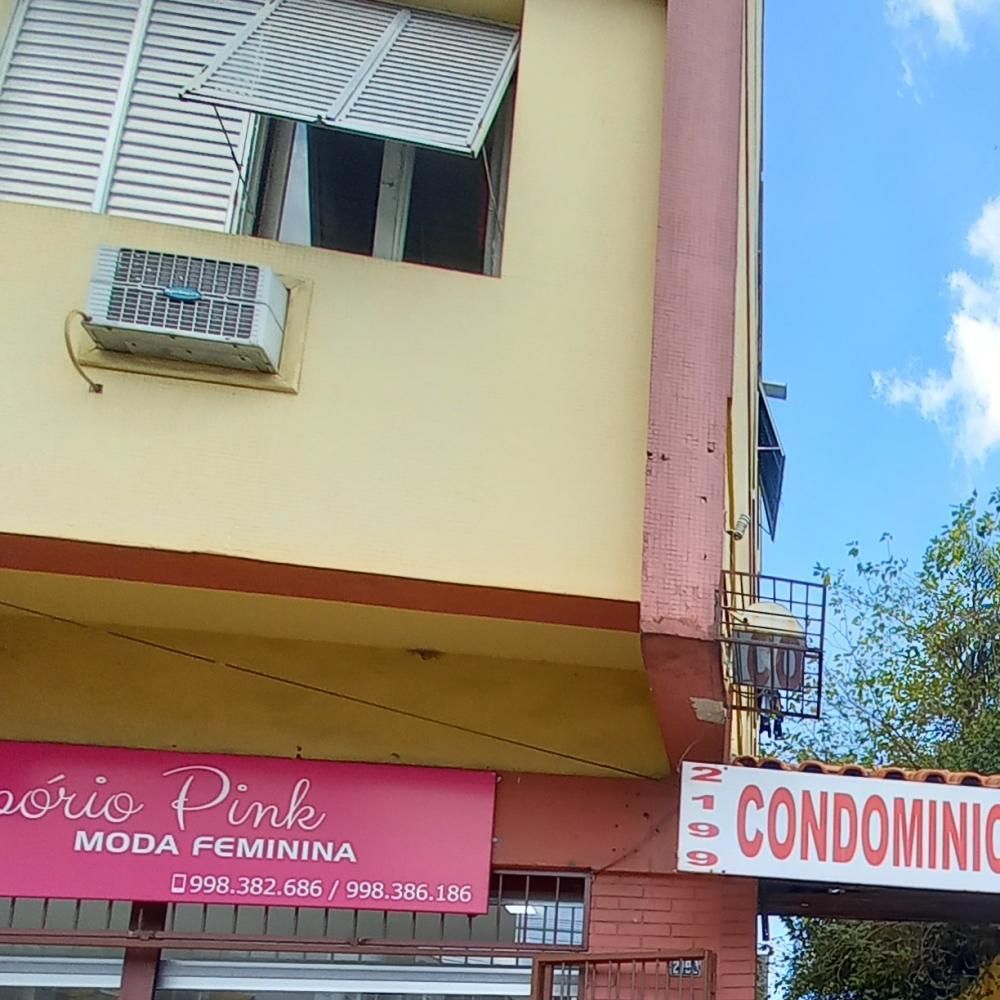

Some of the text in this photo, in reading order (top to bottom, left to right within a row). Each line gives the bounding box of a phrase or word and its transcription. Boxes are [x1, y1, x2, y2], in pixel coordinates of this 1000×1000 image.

[163, 765, 327, 831] Pink
[686, 766, 723, 867] 2199
[74, 830, 358, 863] MODA FEMININA
[189, 875, 323, 898] 998.382.686
[345, 880, 472, 903] 998.386.186
